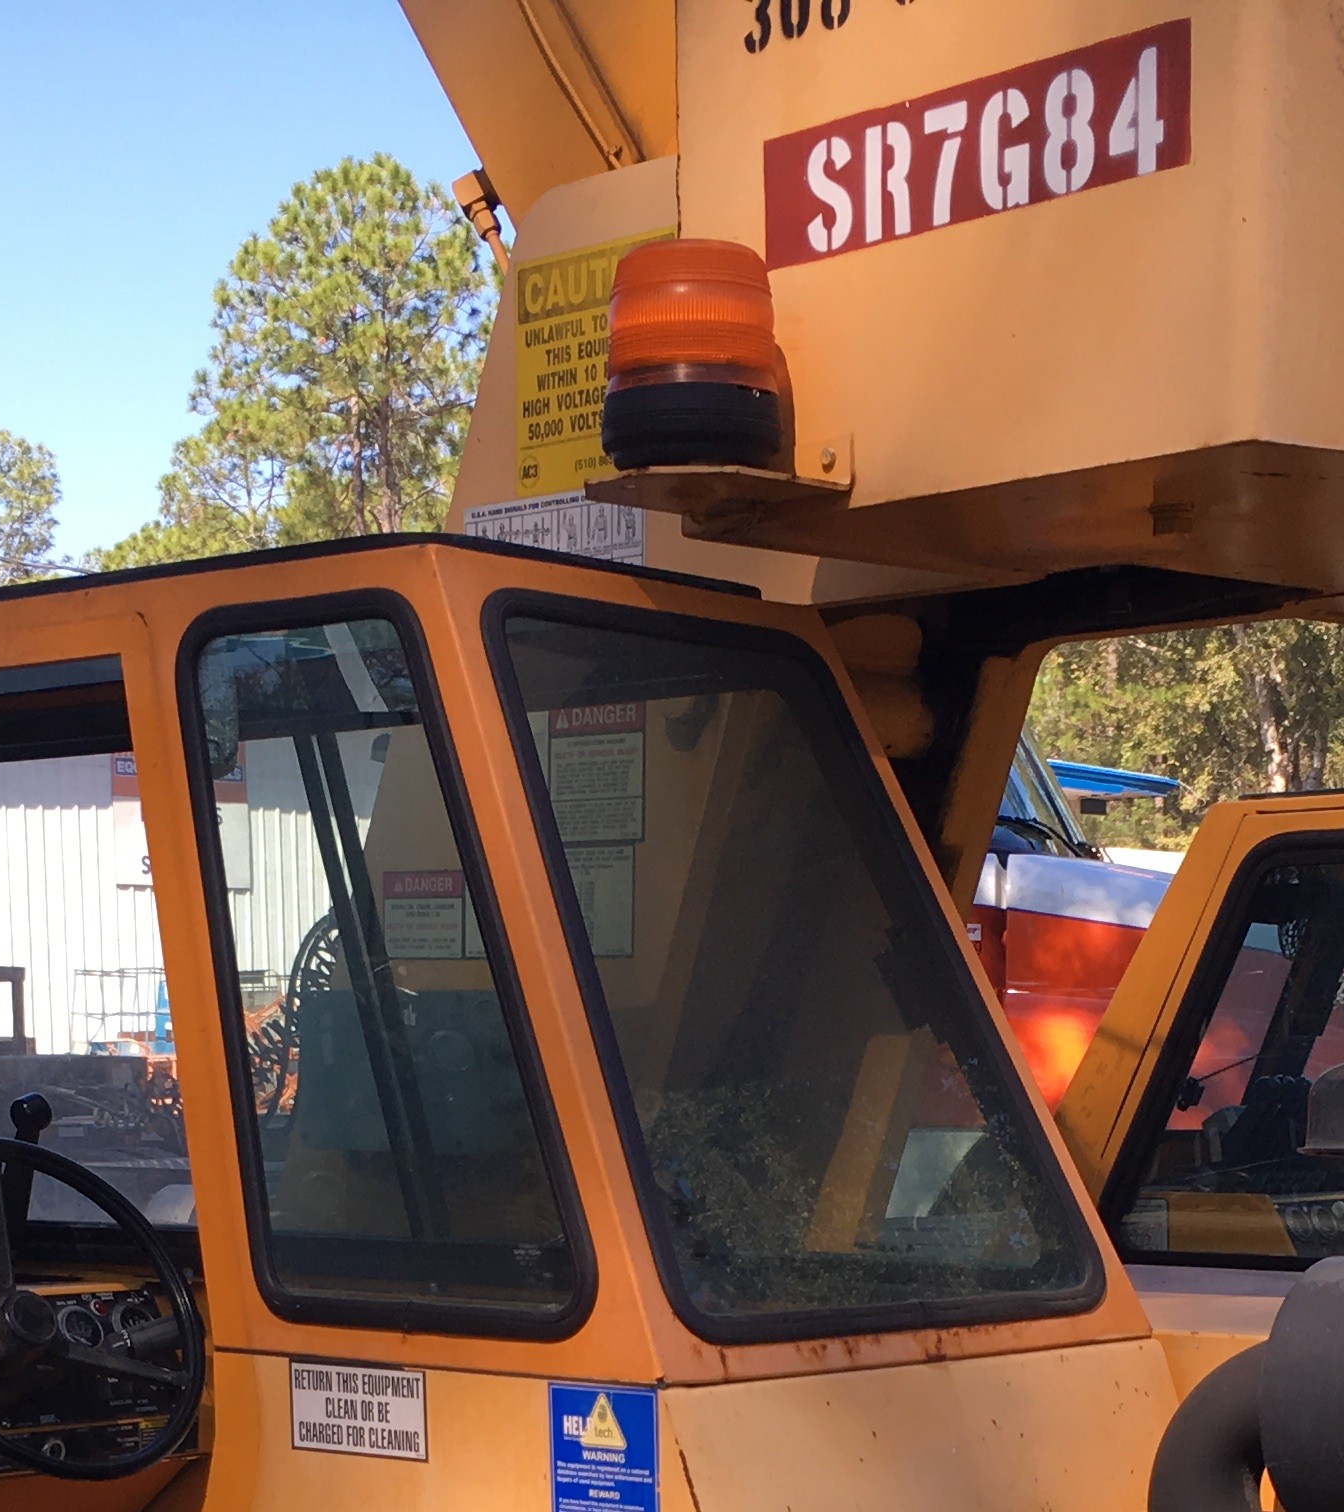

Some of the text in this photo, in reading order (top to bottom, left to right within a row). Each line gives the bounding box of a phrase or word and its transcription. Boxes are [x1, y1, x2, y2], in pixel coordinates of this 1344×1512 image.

[806, 45, 1165, 253] SR7G84
[524, 313, 608, 348] UNLAWFUL TO
[545, 336, 609, 366] THIS EQUI
[536, 363, 597, 392] WITHIN 10
[522, 396, 551, 419] HIGH
[527, 417, 565, 442] 50,000
[571, 703, 637, 727] DANGER
[404, 877, 453, 893] DANGER
[293, 1368, 421, 1400] RETURN THIS EQUIPMENT
[325, 1397, 391, 1424] CLEAN OR BE
[298, 1420, 420, 1453] CHARGED FOR CLEANING
[581, 1449, 626, 1464] WARNING
[588, 1488, 621, 1500] REWARD
